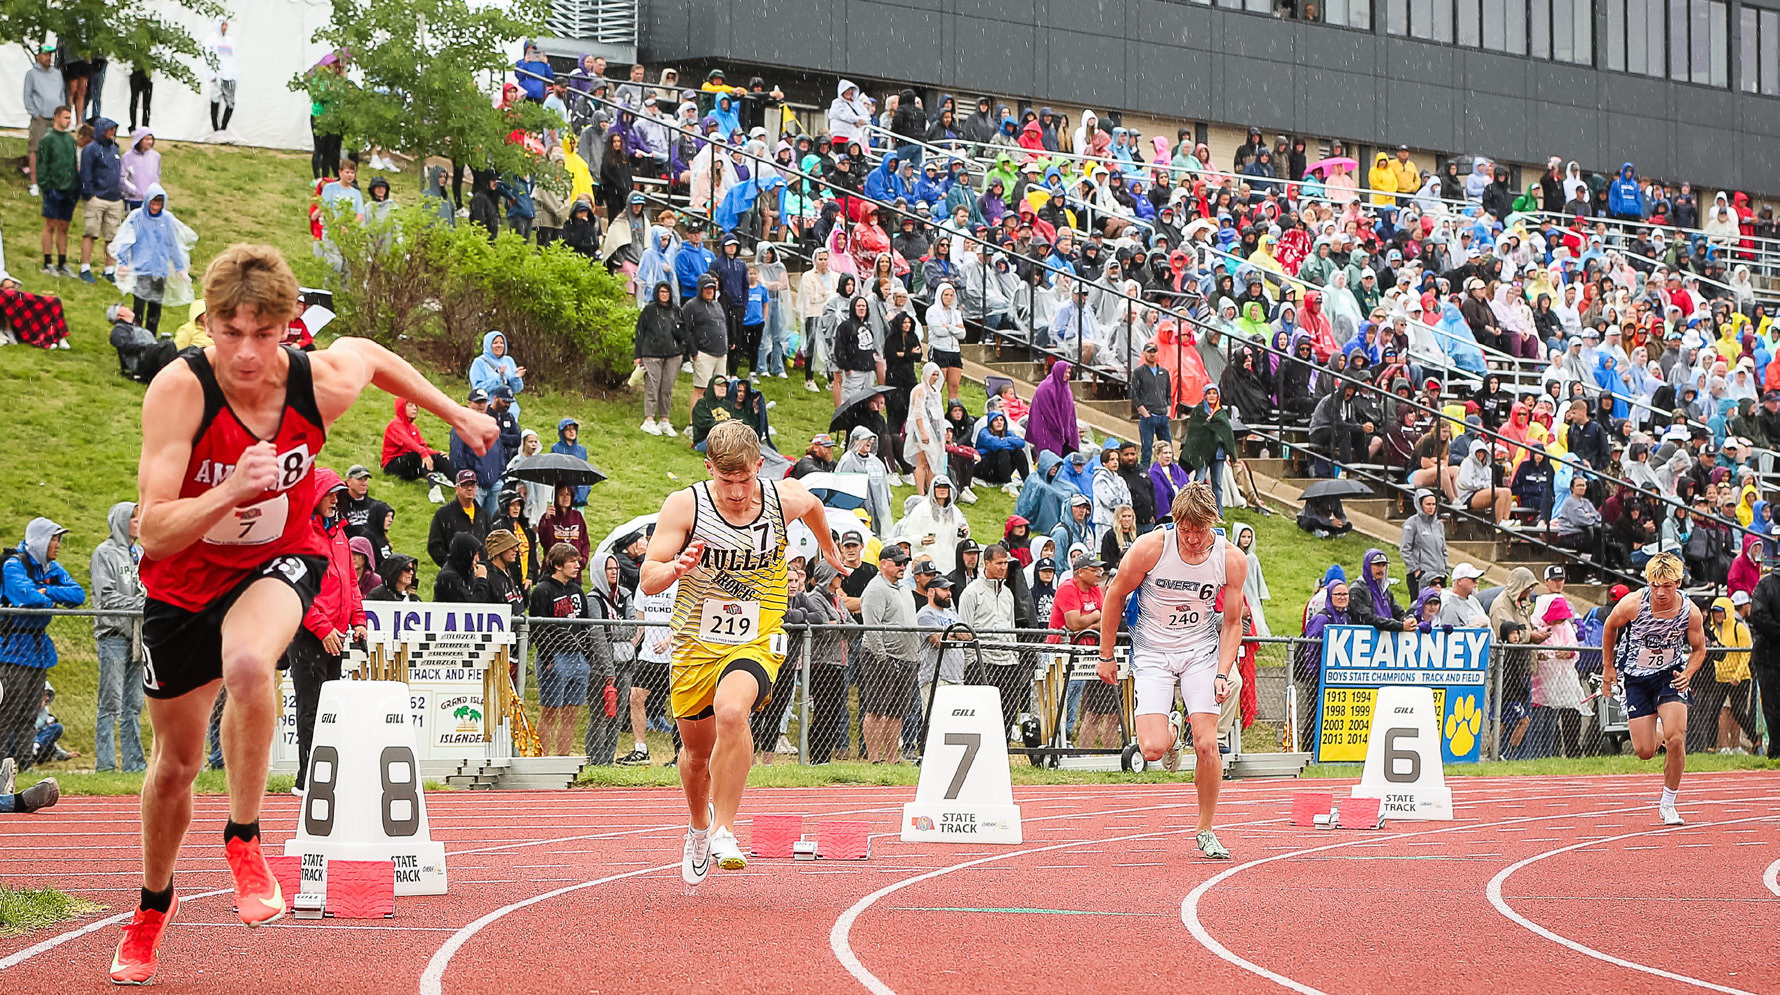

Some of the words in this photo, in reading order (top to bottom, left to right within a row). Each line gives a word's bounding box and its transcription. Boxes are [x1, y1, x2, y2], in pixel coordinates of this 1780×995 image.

[283, 452, 304, 487] 8
[238, 520, 257, 539] 7
[753, 522, 770, 551] 7
[1199, 583, 1214, 600] 6
[393, 610, 504, 640] ISLAND
[1168, 611, 1199, 626] 240
[710, 615, 751, 637] 219
[1326, 628, 1489, 669] KEARNEY
[1648, 655, 1664, 666] 78
[409, 668, 441, 681] TRACK
[445, 668, 464, 681] AND
[468, 668, 482, 681] FIE
[1327, 671, 1348, 682] BOYS
[1349, 671, 1370, 682] STATE
[1371, 672, 1416, 683] CHAMPIONS
[1422, 672, 1445, 683] TRACK
[1445, 673, 1461, 683] AND
[1462, 672, 1480, 683] FIELD
[440, 696, 467, 710] GRAND
[1326, 691, 1347, 703] 1913
[1351, 691, 1371, 703] 1994
[952, 708, 976, 717] GILL
[1325, 705, 1346, 717] 1998
[1350, 705, 1370, 717] 1999
[1394, 706, 1414, 714] GILL
[321, 713, 338, 724] GILL
[385, 713, 405, 724] GILL
[1323, 719, 1344, 731] 2003
[1348, 719, 1369, 731] 2004
[1322, 733, 1343, 745] 2013
[1347, 733, 1368, 745] 2014
[1383, 727, 1421, 784] 6
[943, 732, 981, 800] 7
[305, 745, 339, 837] 8
[379, 746, 420, 838] 8
[1386, 794, 1415, 803] STATE
[1384, 803, 1416, 812] TRACK
[942, 812, 976, 823] STATE
[940, 823, 978, 833] TRACK
[303, 853, 324, 867] STATE
[391, 855, 418, 868] STATE
[301, 868, 324, 882] TRACK
